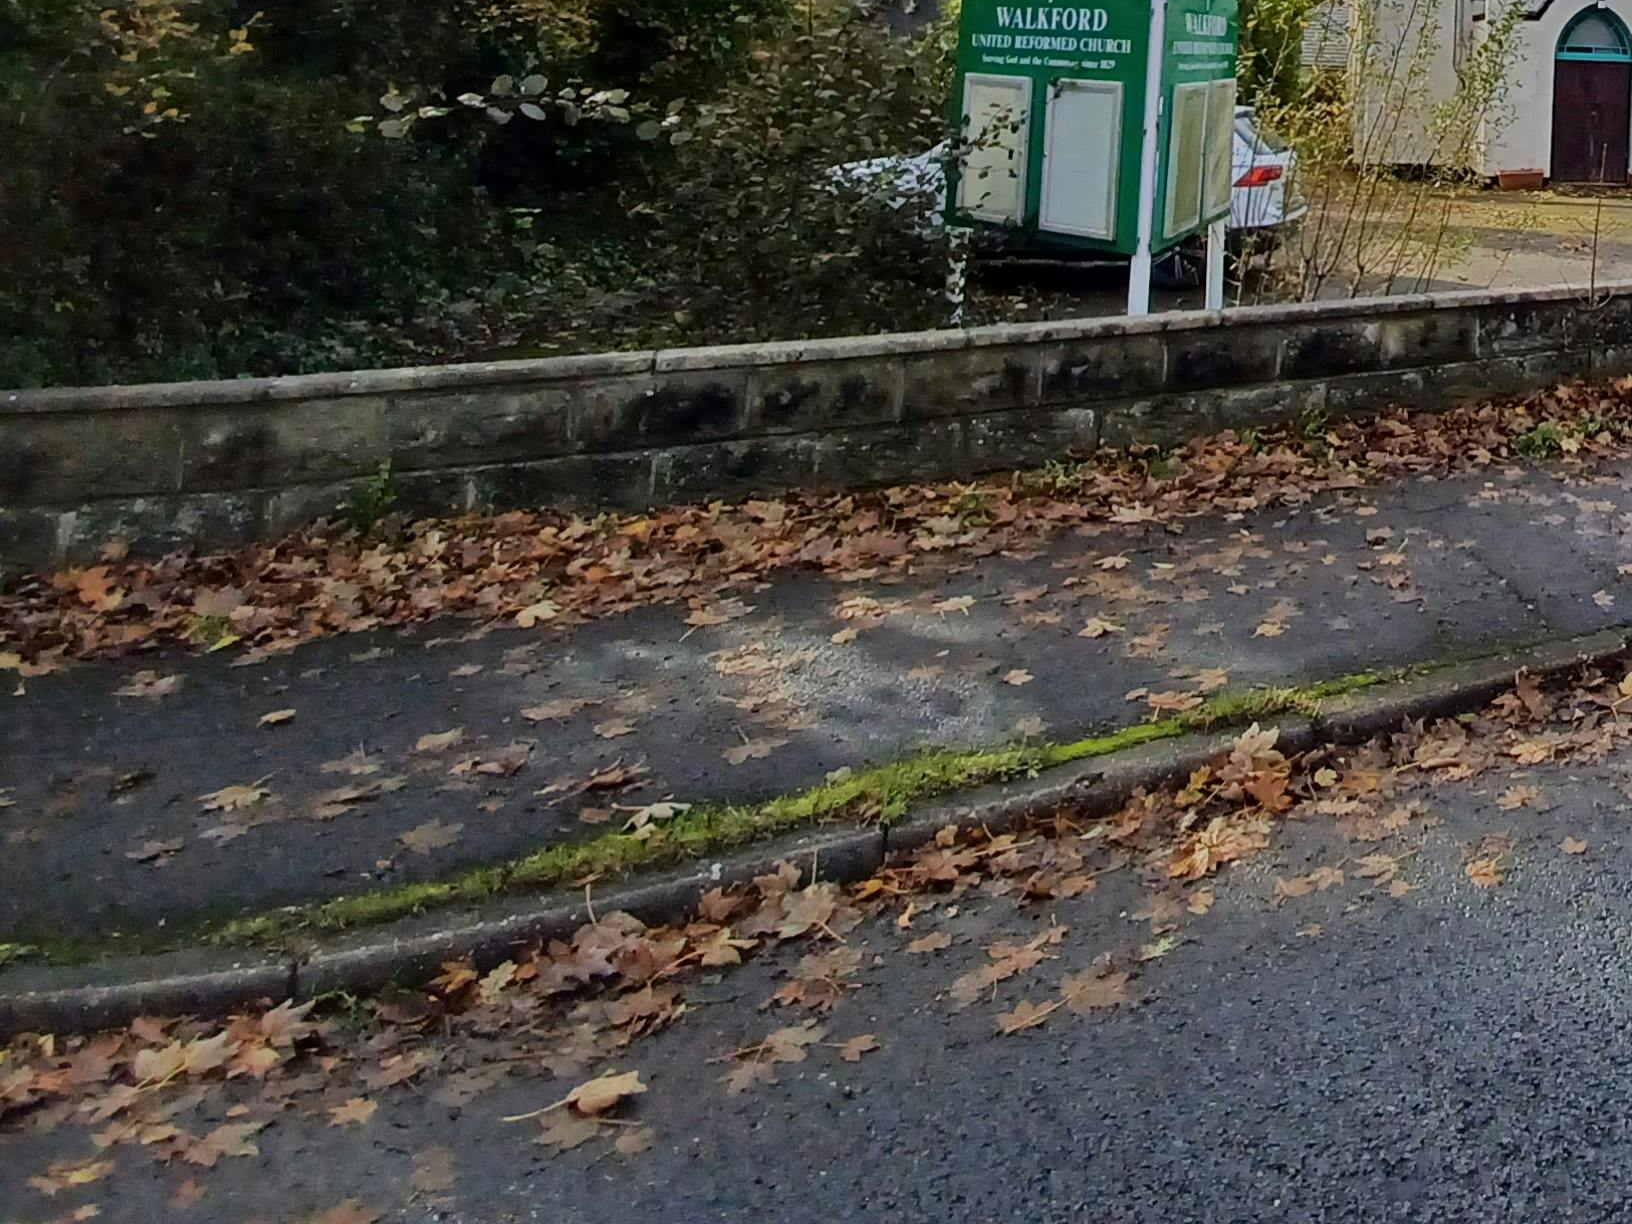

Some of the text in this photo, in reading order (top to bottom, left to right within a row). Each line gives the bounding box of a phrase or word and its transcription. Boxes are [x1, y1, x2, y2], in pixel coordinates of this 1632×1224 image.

[996, 6, 1108, 31] WALKFORD
[971, 33, 1131, 53] UNITED REFORMED CHURCH
